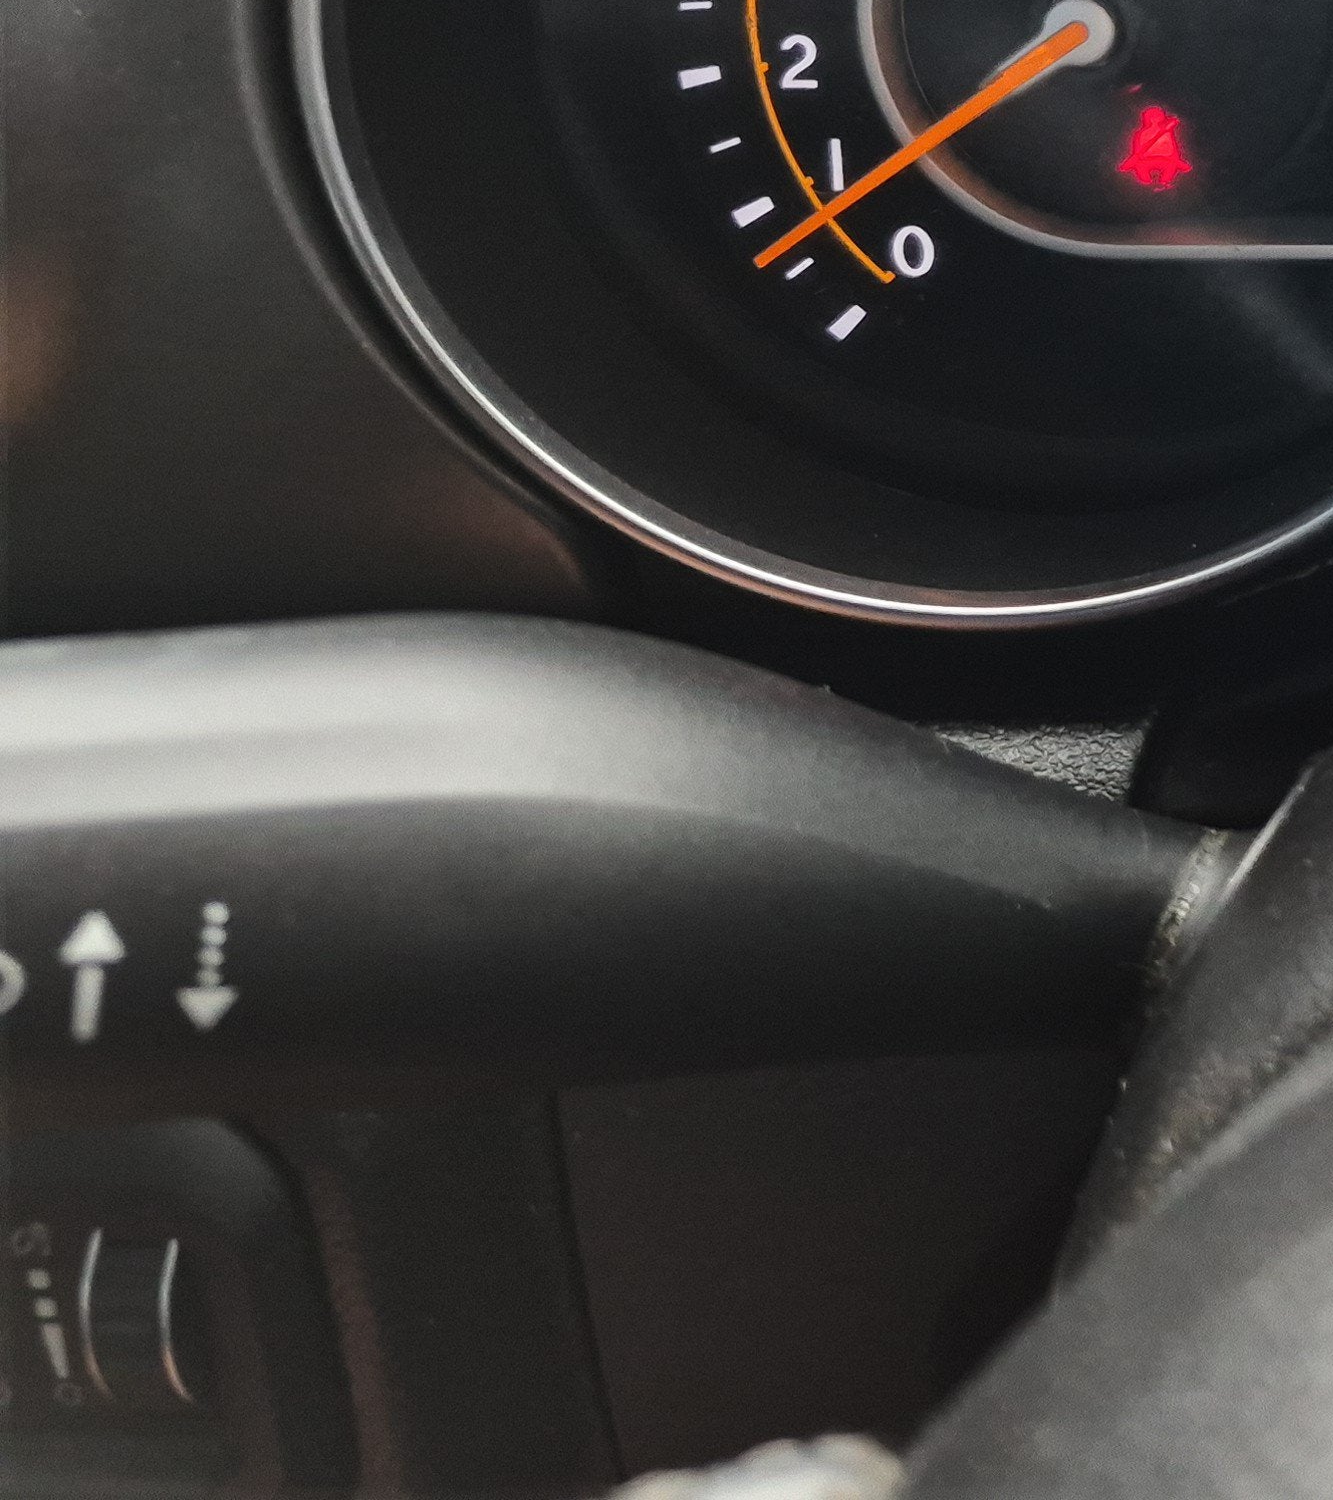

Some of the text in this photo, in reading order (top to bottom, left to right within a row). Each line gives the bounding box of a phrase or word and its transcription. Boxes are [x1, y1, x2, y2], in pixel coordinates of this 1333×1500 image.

[779, 33, 820, 90] 2
[829, 137, 846, 193] 1
[890, 224, 936, 279] 0
